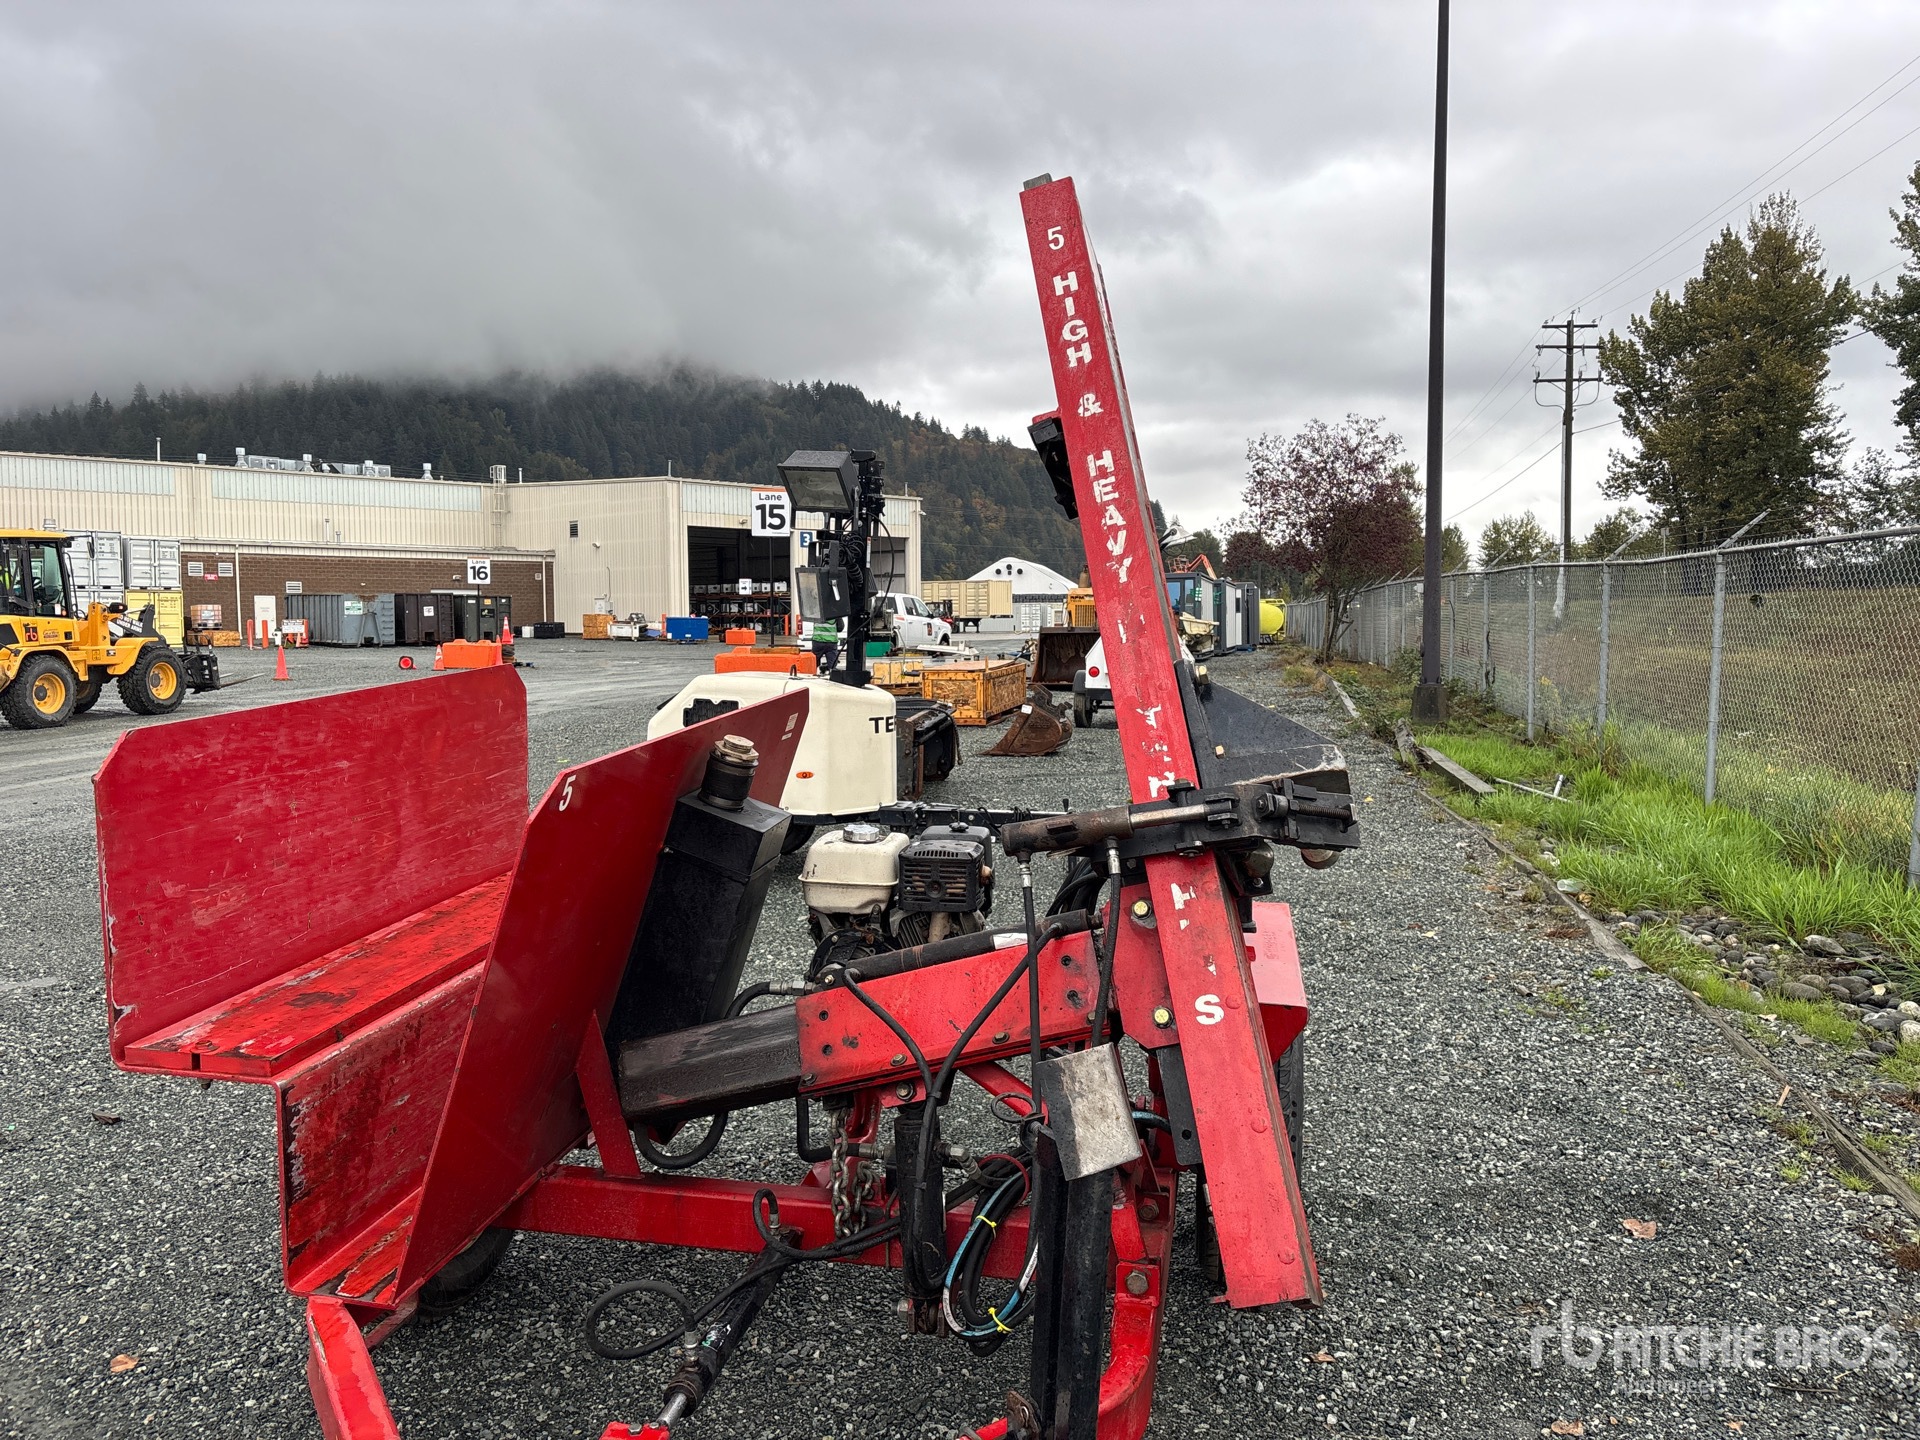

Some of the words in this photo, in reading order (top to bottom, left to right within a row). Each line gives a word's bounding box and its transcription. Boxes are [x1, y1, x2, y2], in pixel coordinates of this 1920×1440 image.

[1047, 226, 1065, 250] 5
[1053, 271, 1092, 368] HIGH
[1077, 393, 1104, 417] &
[758, 493, 782, 501] Lane
[755, 504, 786, 530] 15
[1087, 450, 1133, 584] HEAVY
[803, 534, 811, 546] 3
[469, 566, 489, 580] 16
[869, 716, 896, 734] TE
[559, 775, 576, 811] 5
